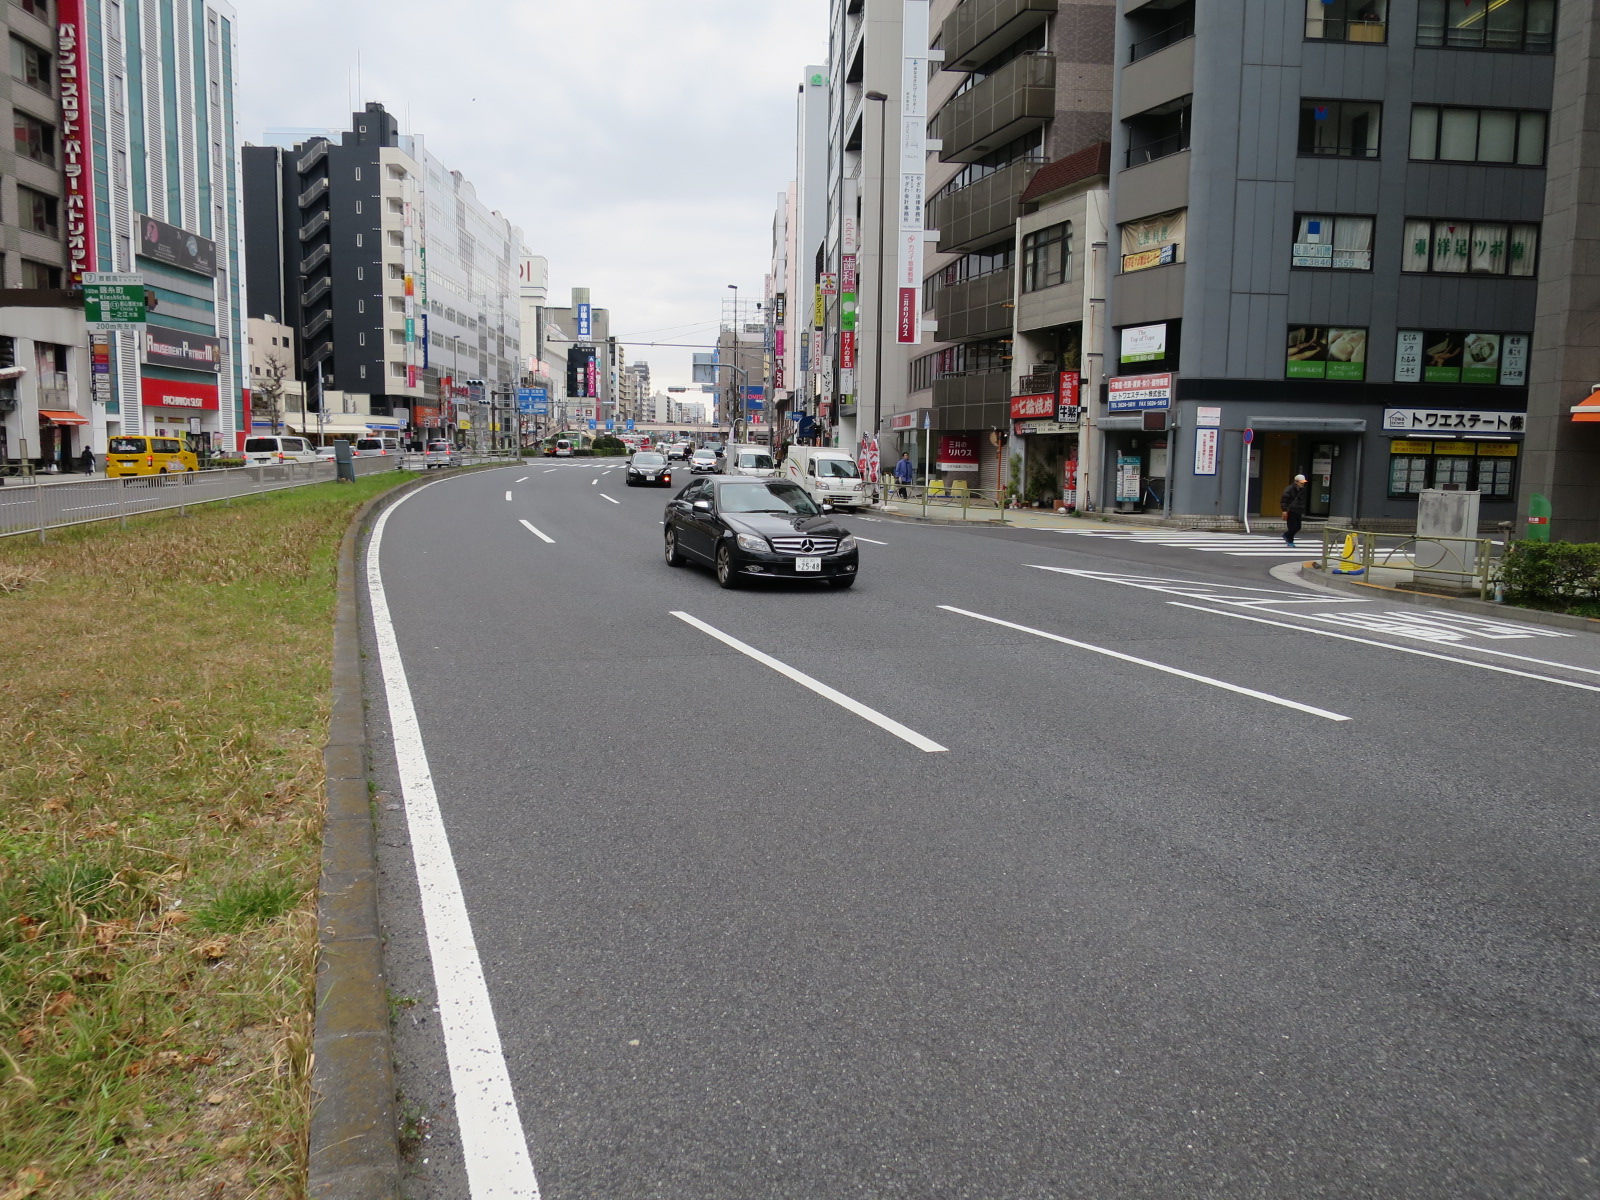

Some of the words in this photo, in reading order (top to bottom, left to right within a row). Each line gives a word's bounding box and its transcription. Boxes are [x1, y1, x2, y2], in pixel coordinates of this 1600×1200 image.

[843, 258, 855, 284] 歯科
[902, 294, 910, 337] 三井のリハウス
[948, 440, 967, 449] 三井の
[948, 449, 973, 457] リハウス
